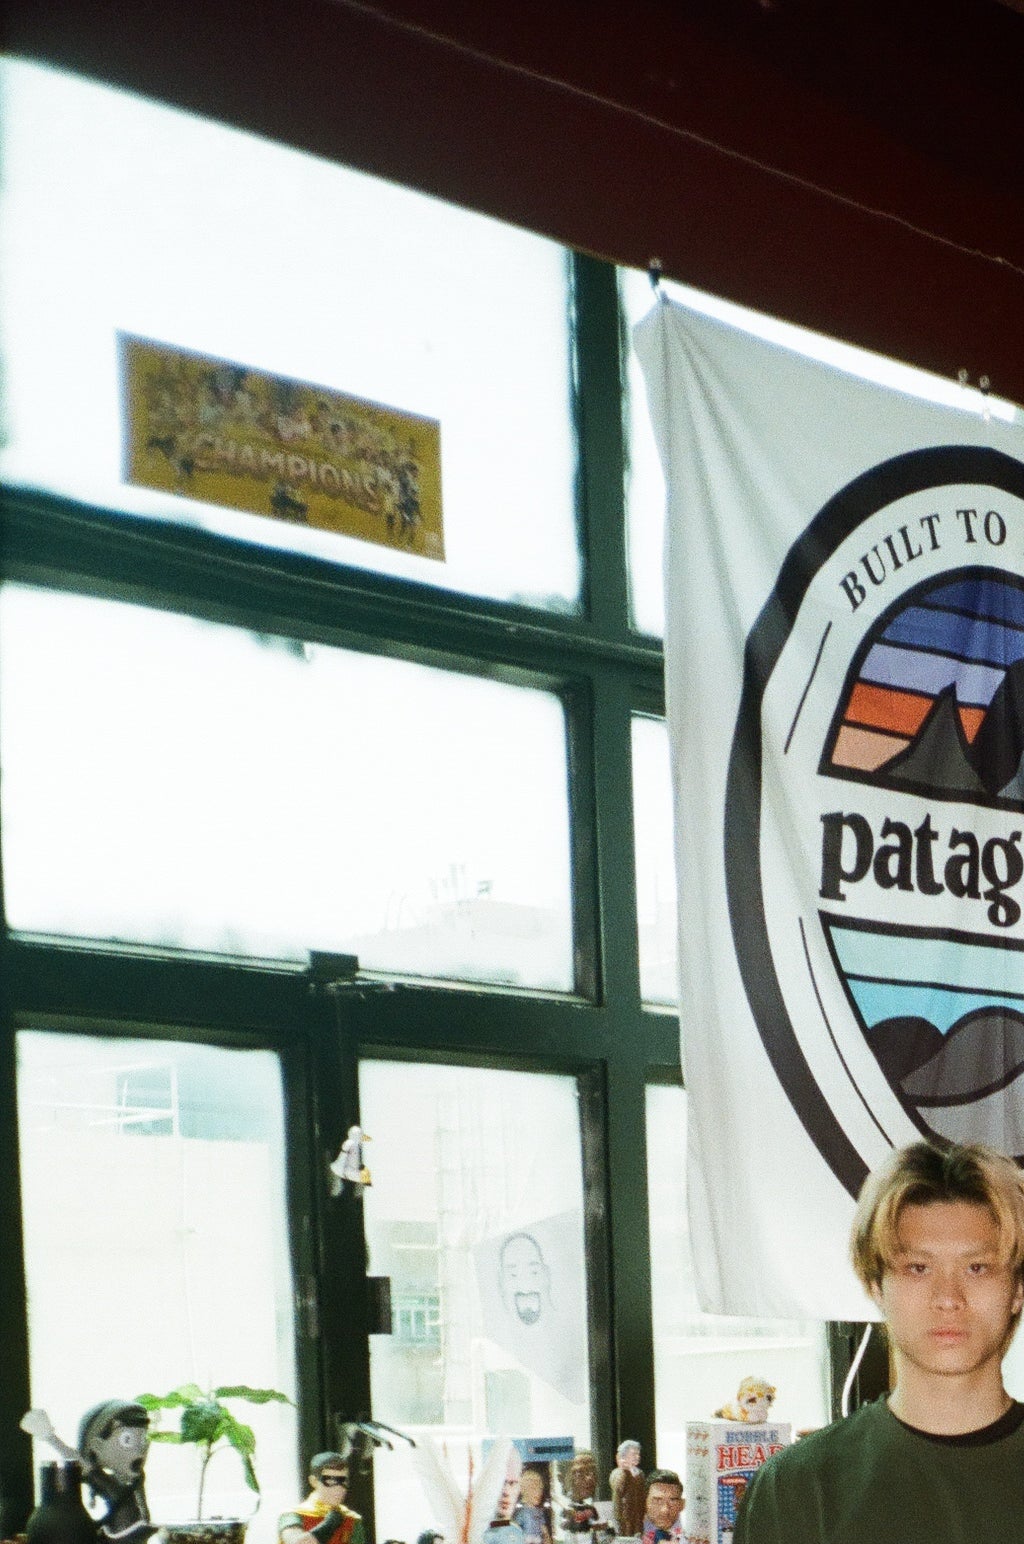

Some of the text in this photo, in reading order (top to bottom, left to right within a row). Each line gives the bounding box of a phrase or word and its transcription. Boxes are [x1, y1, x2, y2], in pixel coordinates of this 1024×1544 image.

[193, 432, 383, 513] CHAMPIONS
[838, 513, 942, 613] BUILT
[956, 508, 1007, 546] TO
